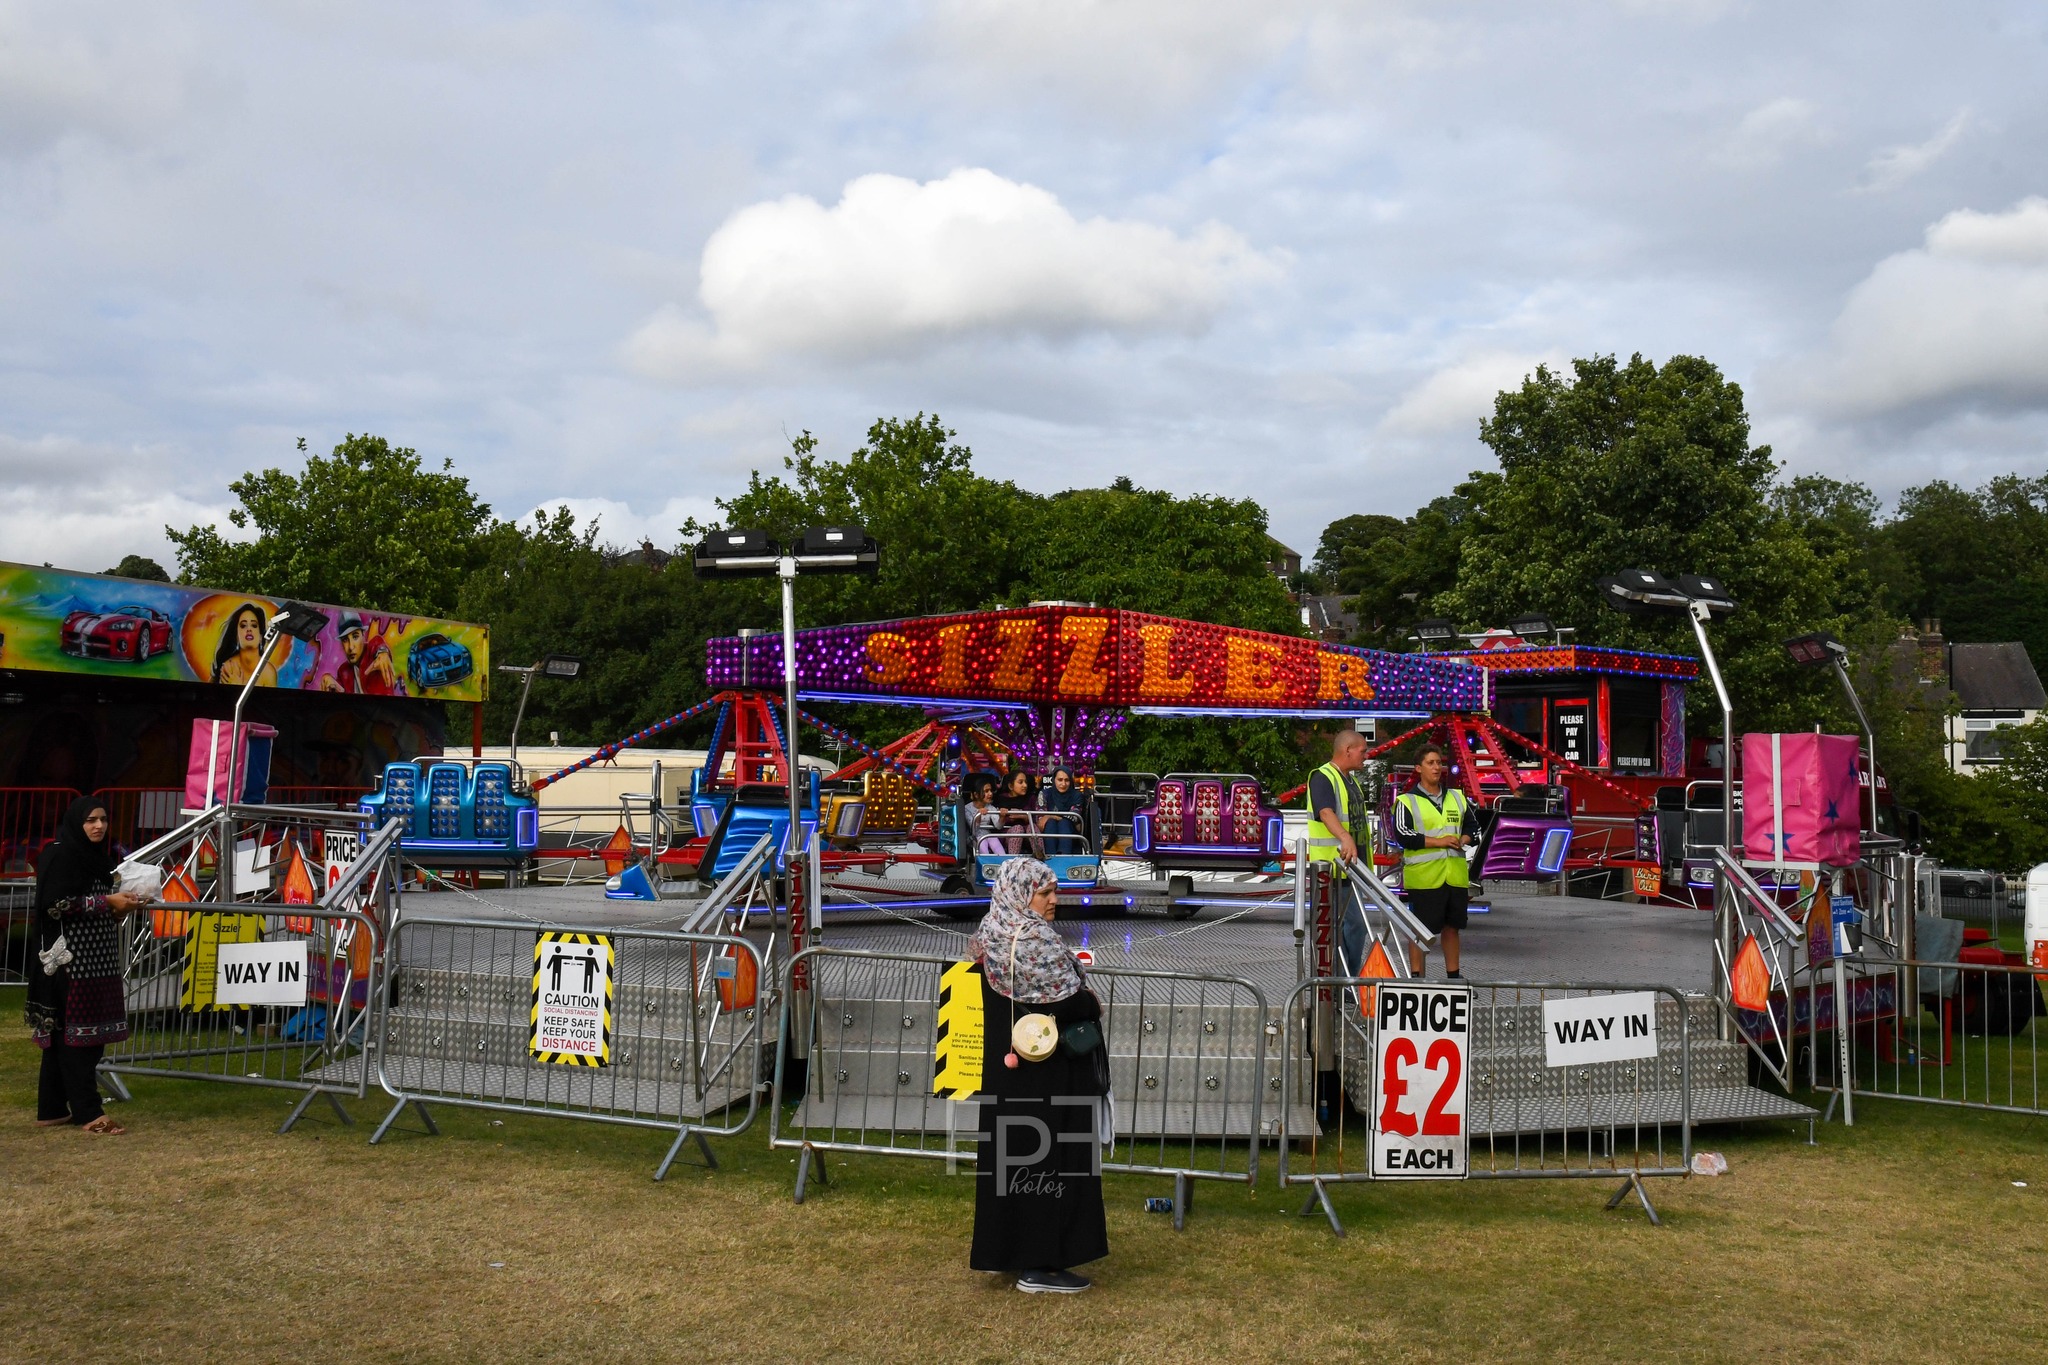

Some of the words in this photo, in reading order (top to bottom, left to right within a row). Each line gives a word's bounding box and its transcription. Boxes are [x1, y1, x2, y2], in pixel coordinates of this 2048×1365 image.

[862, 615, 1376, 701] SIZZLER
[1560, 714, 1584, 724] PLEASE
[1566, 727, 1578, 736] PAY
[1568, 739, 1576, 748] IN
[1565, 751, 1579, 760] CAR
[1617, 757, 1631, 766] PLEASE
[326, 836, 356, 862] PRICE
[213, 923, 241, 933] Szzler
[224, 962, 272, 984] WAY
[278, 961, 300, 982] IN
[545, 993, 599, 1008] CAUTION
[565, 1009, 598, 1017] DISTANCING
[1380, 992, 1467, 1033] PRICE
[544, 1016, 569, 1026] KEEP
[571, 1018, 596, 1029] SAFE
[1554, 1016, 1615, 1044] WAY
[1623, 1014, 1649, 1039] IN
[543, 1026, 567, 1036] KEEP
[570, 1029, 596, 1040] YOUR
[542, 1037, 596, 1052] DISTANCE
[1380, 1037, 1462, 1138] £2
[1386, 1149, 1454, 1170] EACH
